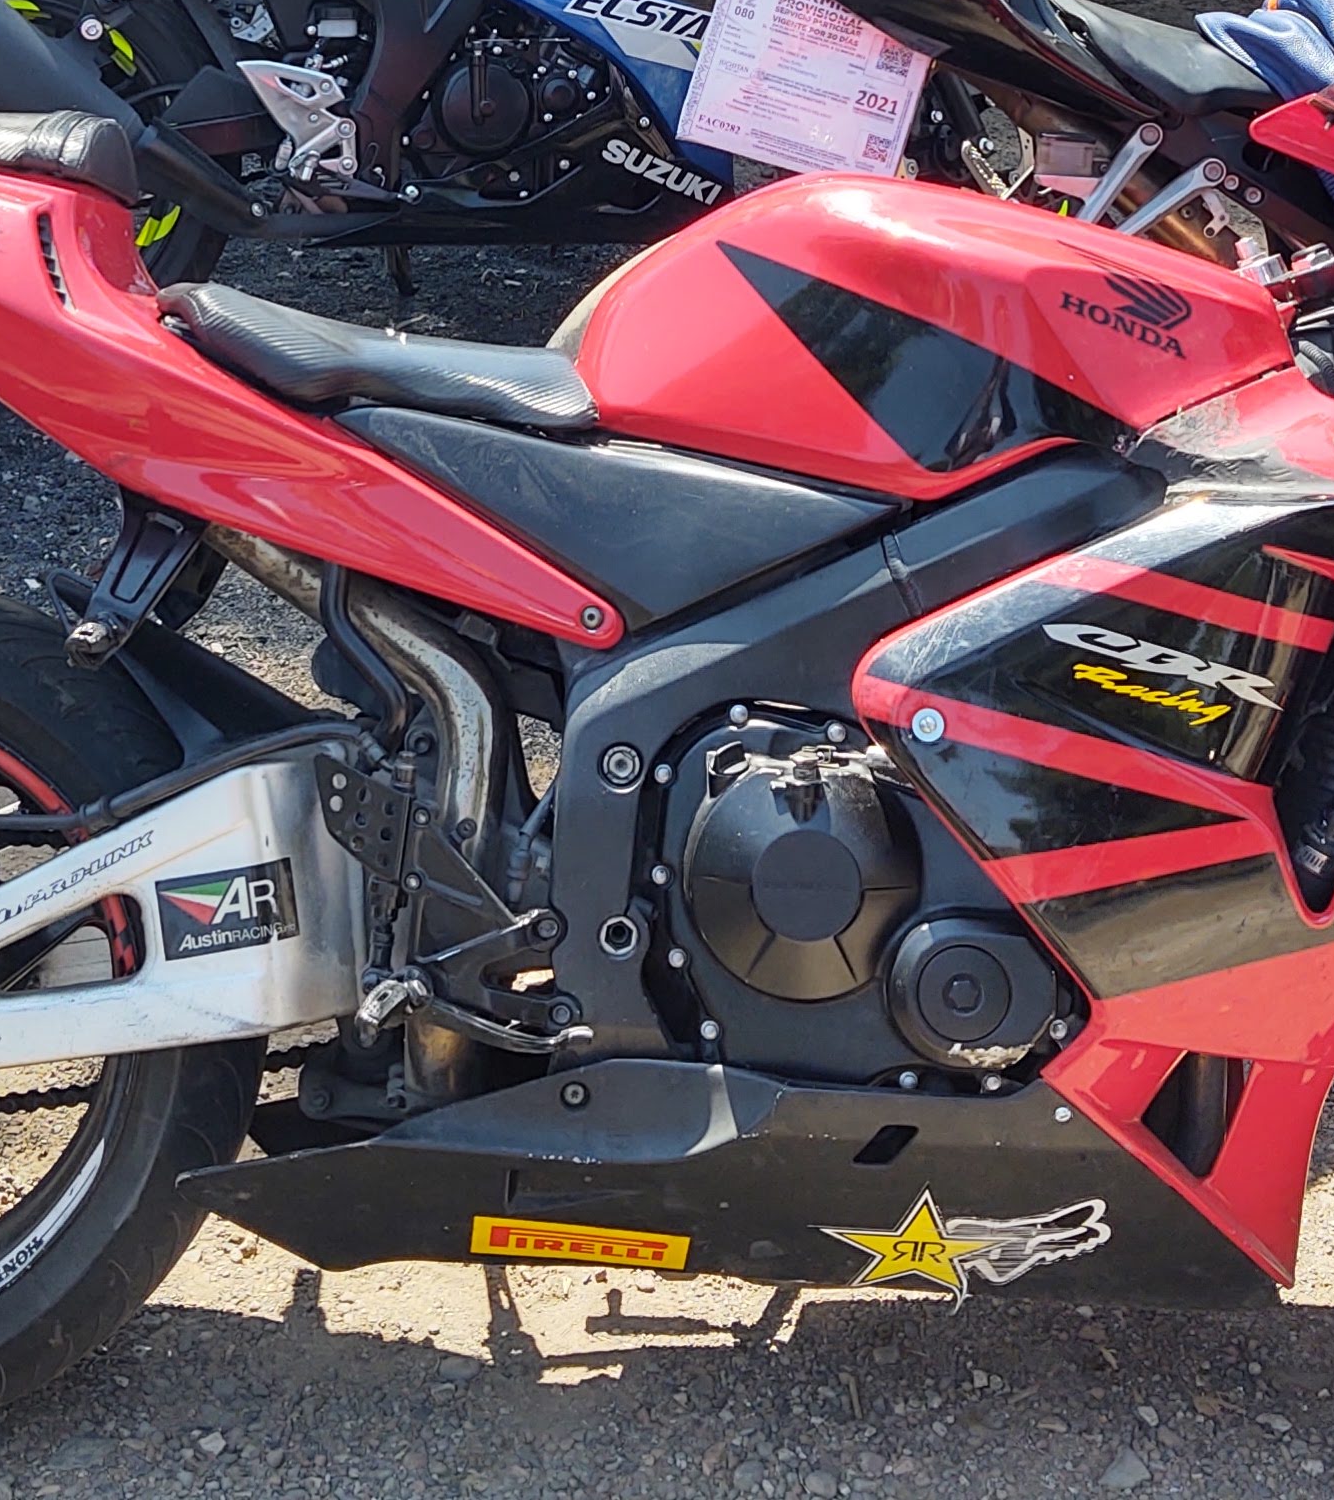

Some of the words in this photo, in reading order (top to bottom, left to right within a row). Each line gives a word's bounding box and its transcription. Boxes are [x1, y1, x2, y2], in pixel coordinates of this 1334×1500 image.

[732, 5, 756, 22] 080
[855, 90, 898, 116] 2021
[602, 138, 723, 206] SUZUKI
[1060, 291, 1187, 360] HONDA
[1073, 663, 1232, 727] Racing
[210, 875, 277, 925] AR
[488, 1225, 671, 1262] PIRELLI
